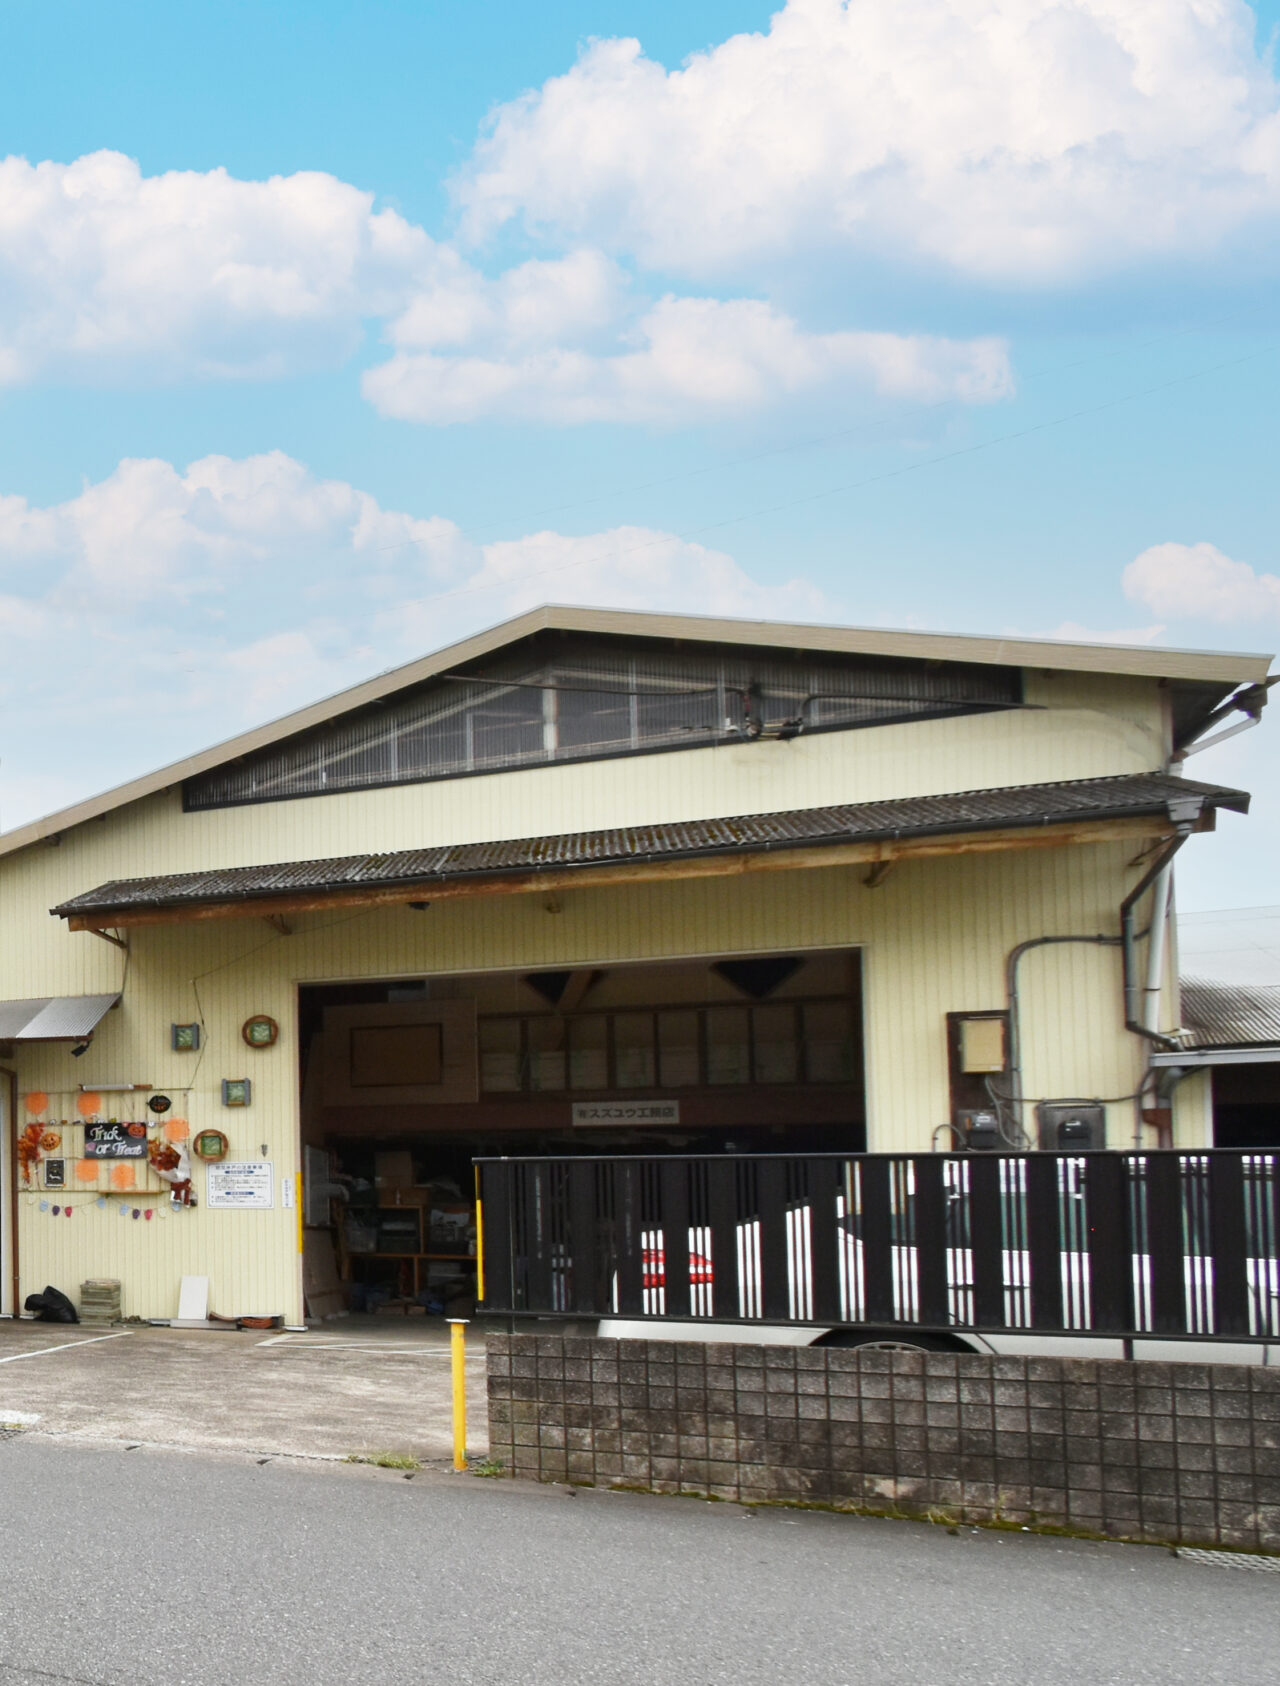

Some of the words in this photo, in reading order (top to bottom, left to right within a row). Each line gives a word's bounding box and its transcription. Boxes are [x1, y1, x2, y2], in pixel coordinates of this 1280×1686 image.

[90, 1125, 122, 1141] Trick
[95, 1144, 111, 1155] or
[112, 1141, 142, 1156] Treat
